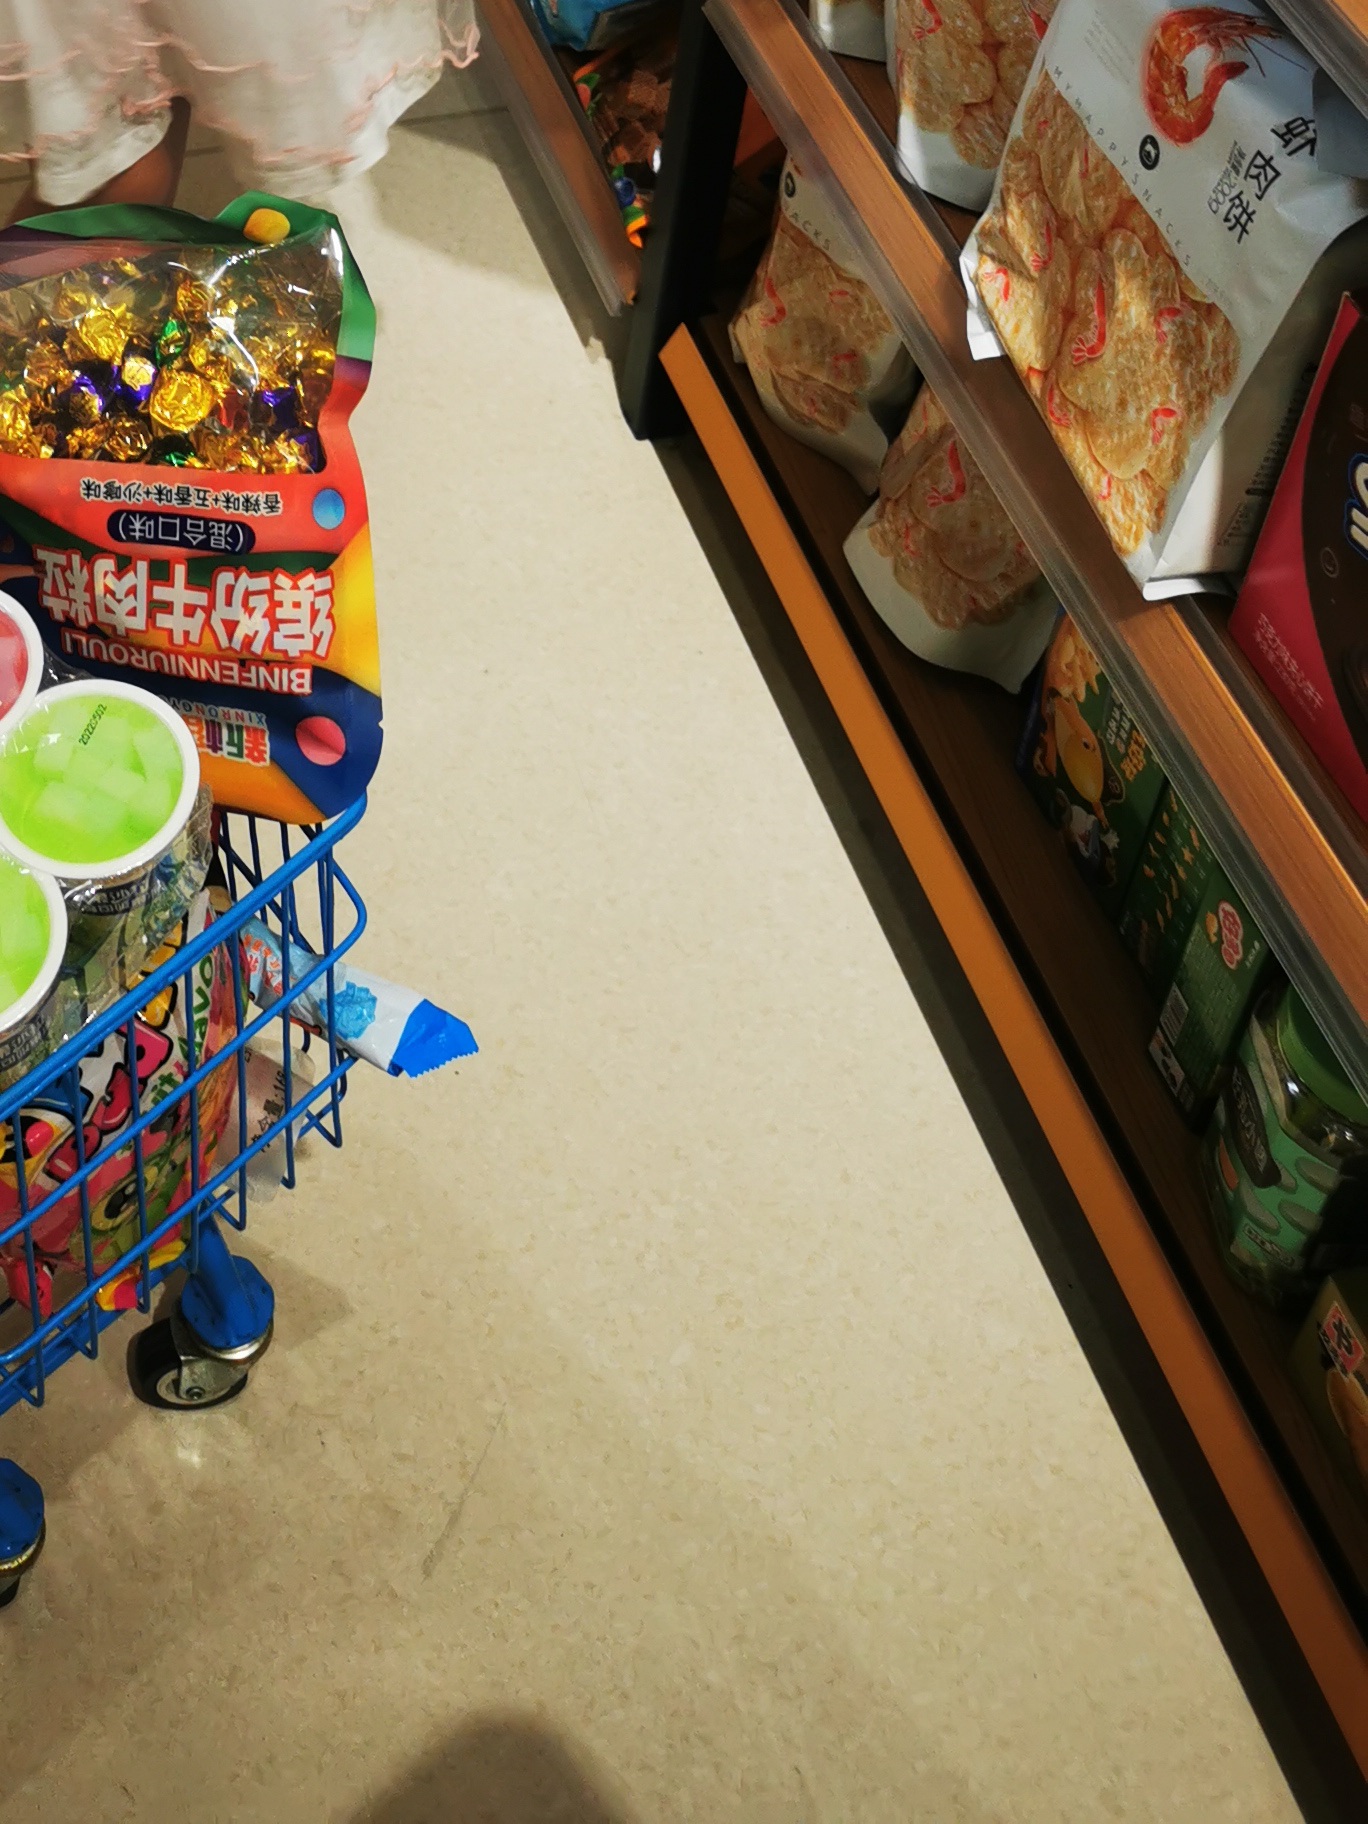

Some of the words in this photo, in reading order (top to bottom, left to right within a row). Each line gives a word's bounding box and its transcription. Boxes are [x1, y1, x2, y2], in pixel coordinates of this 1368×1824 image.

[1073, 96, 1130, 166] HAPPY
[1131, 174, 1191, 270] SNACKS
[1223, 116, 1318, 245] 虾肉饼
[37, 546, 335, 658] 缤纷牛肉粒
[62, 629, 313, 694] BINFENNIUROULI
[78, 703, 107, 747] 20220502
